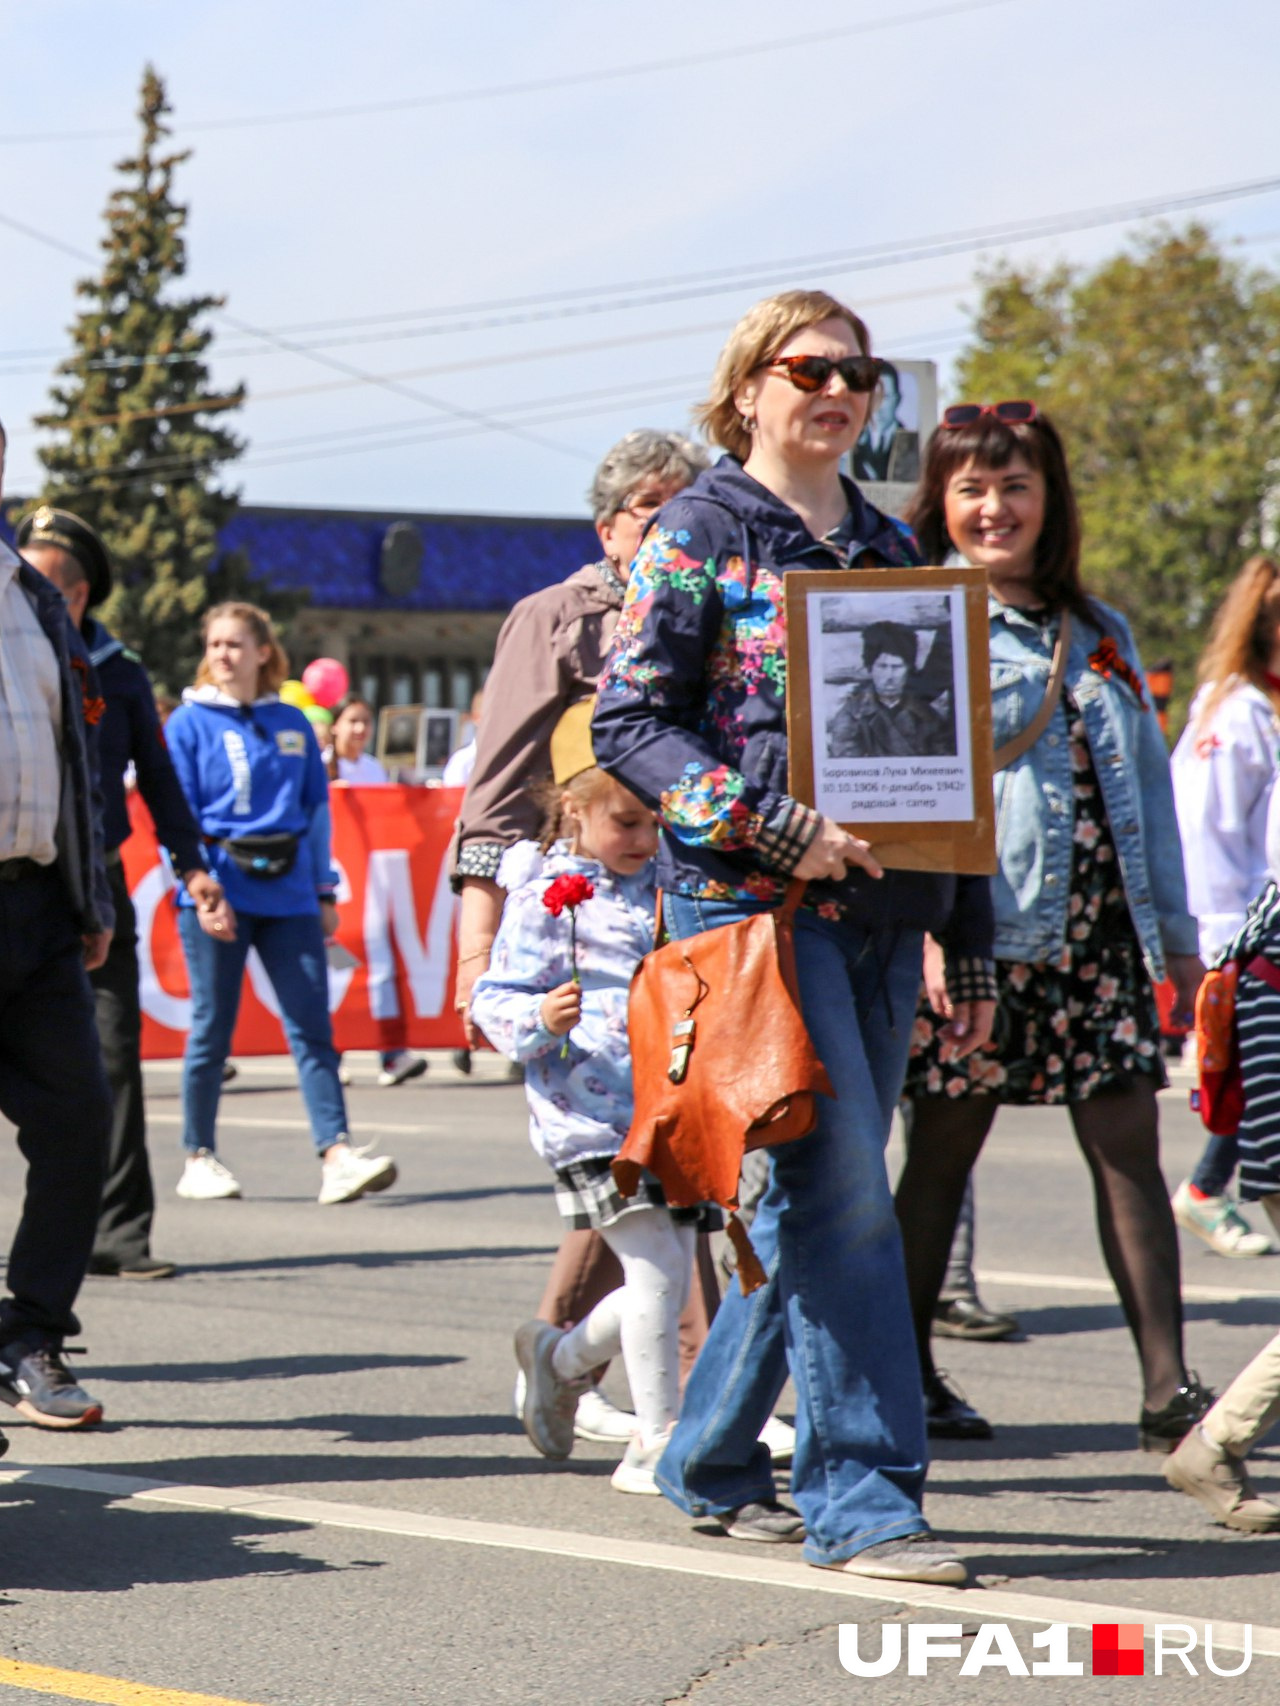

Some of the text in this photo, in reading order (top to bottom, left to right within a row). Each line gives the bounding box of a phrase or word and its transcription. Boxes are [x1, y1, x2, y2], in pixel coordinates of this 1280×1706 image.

[822, 765, 964, 779] Боровиков Лука Михеевич
[850, 798, 897, 810] рядовой
[905, 799, 938, 810] сапер
